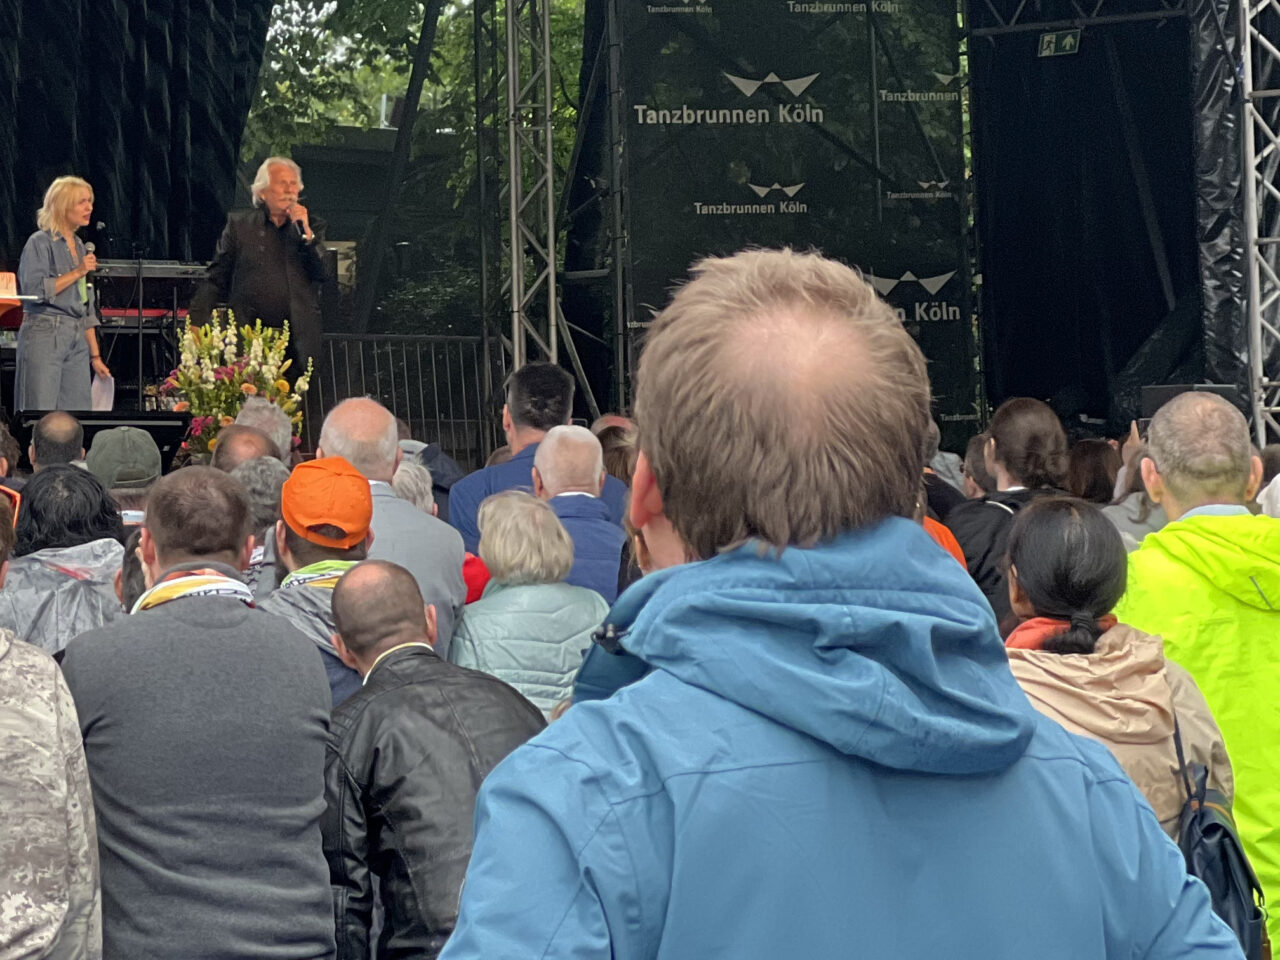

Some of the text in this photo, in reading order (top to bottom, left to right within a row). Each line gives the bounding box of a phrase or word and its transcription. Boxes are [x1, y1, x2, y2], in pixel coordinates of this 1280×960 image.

[646, 4, 694, 13] Tanzbrunnen
[786, 0, 899, 13] Tanzbrunnen Köln
[879, 89, 959, 101] Tanzbrunnen
[633, 103, 824, 125] Tanzbrunnen Köln
[694, 201, 808, 215] Tanzbrunnen Köln
[914, 301, 961, 322] Köln
